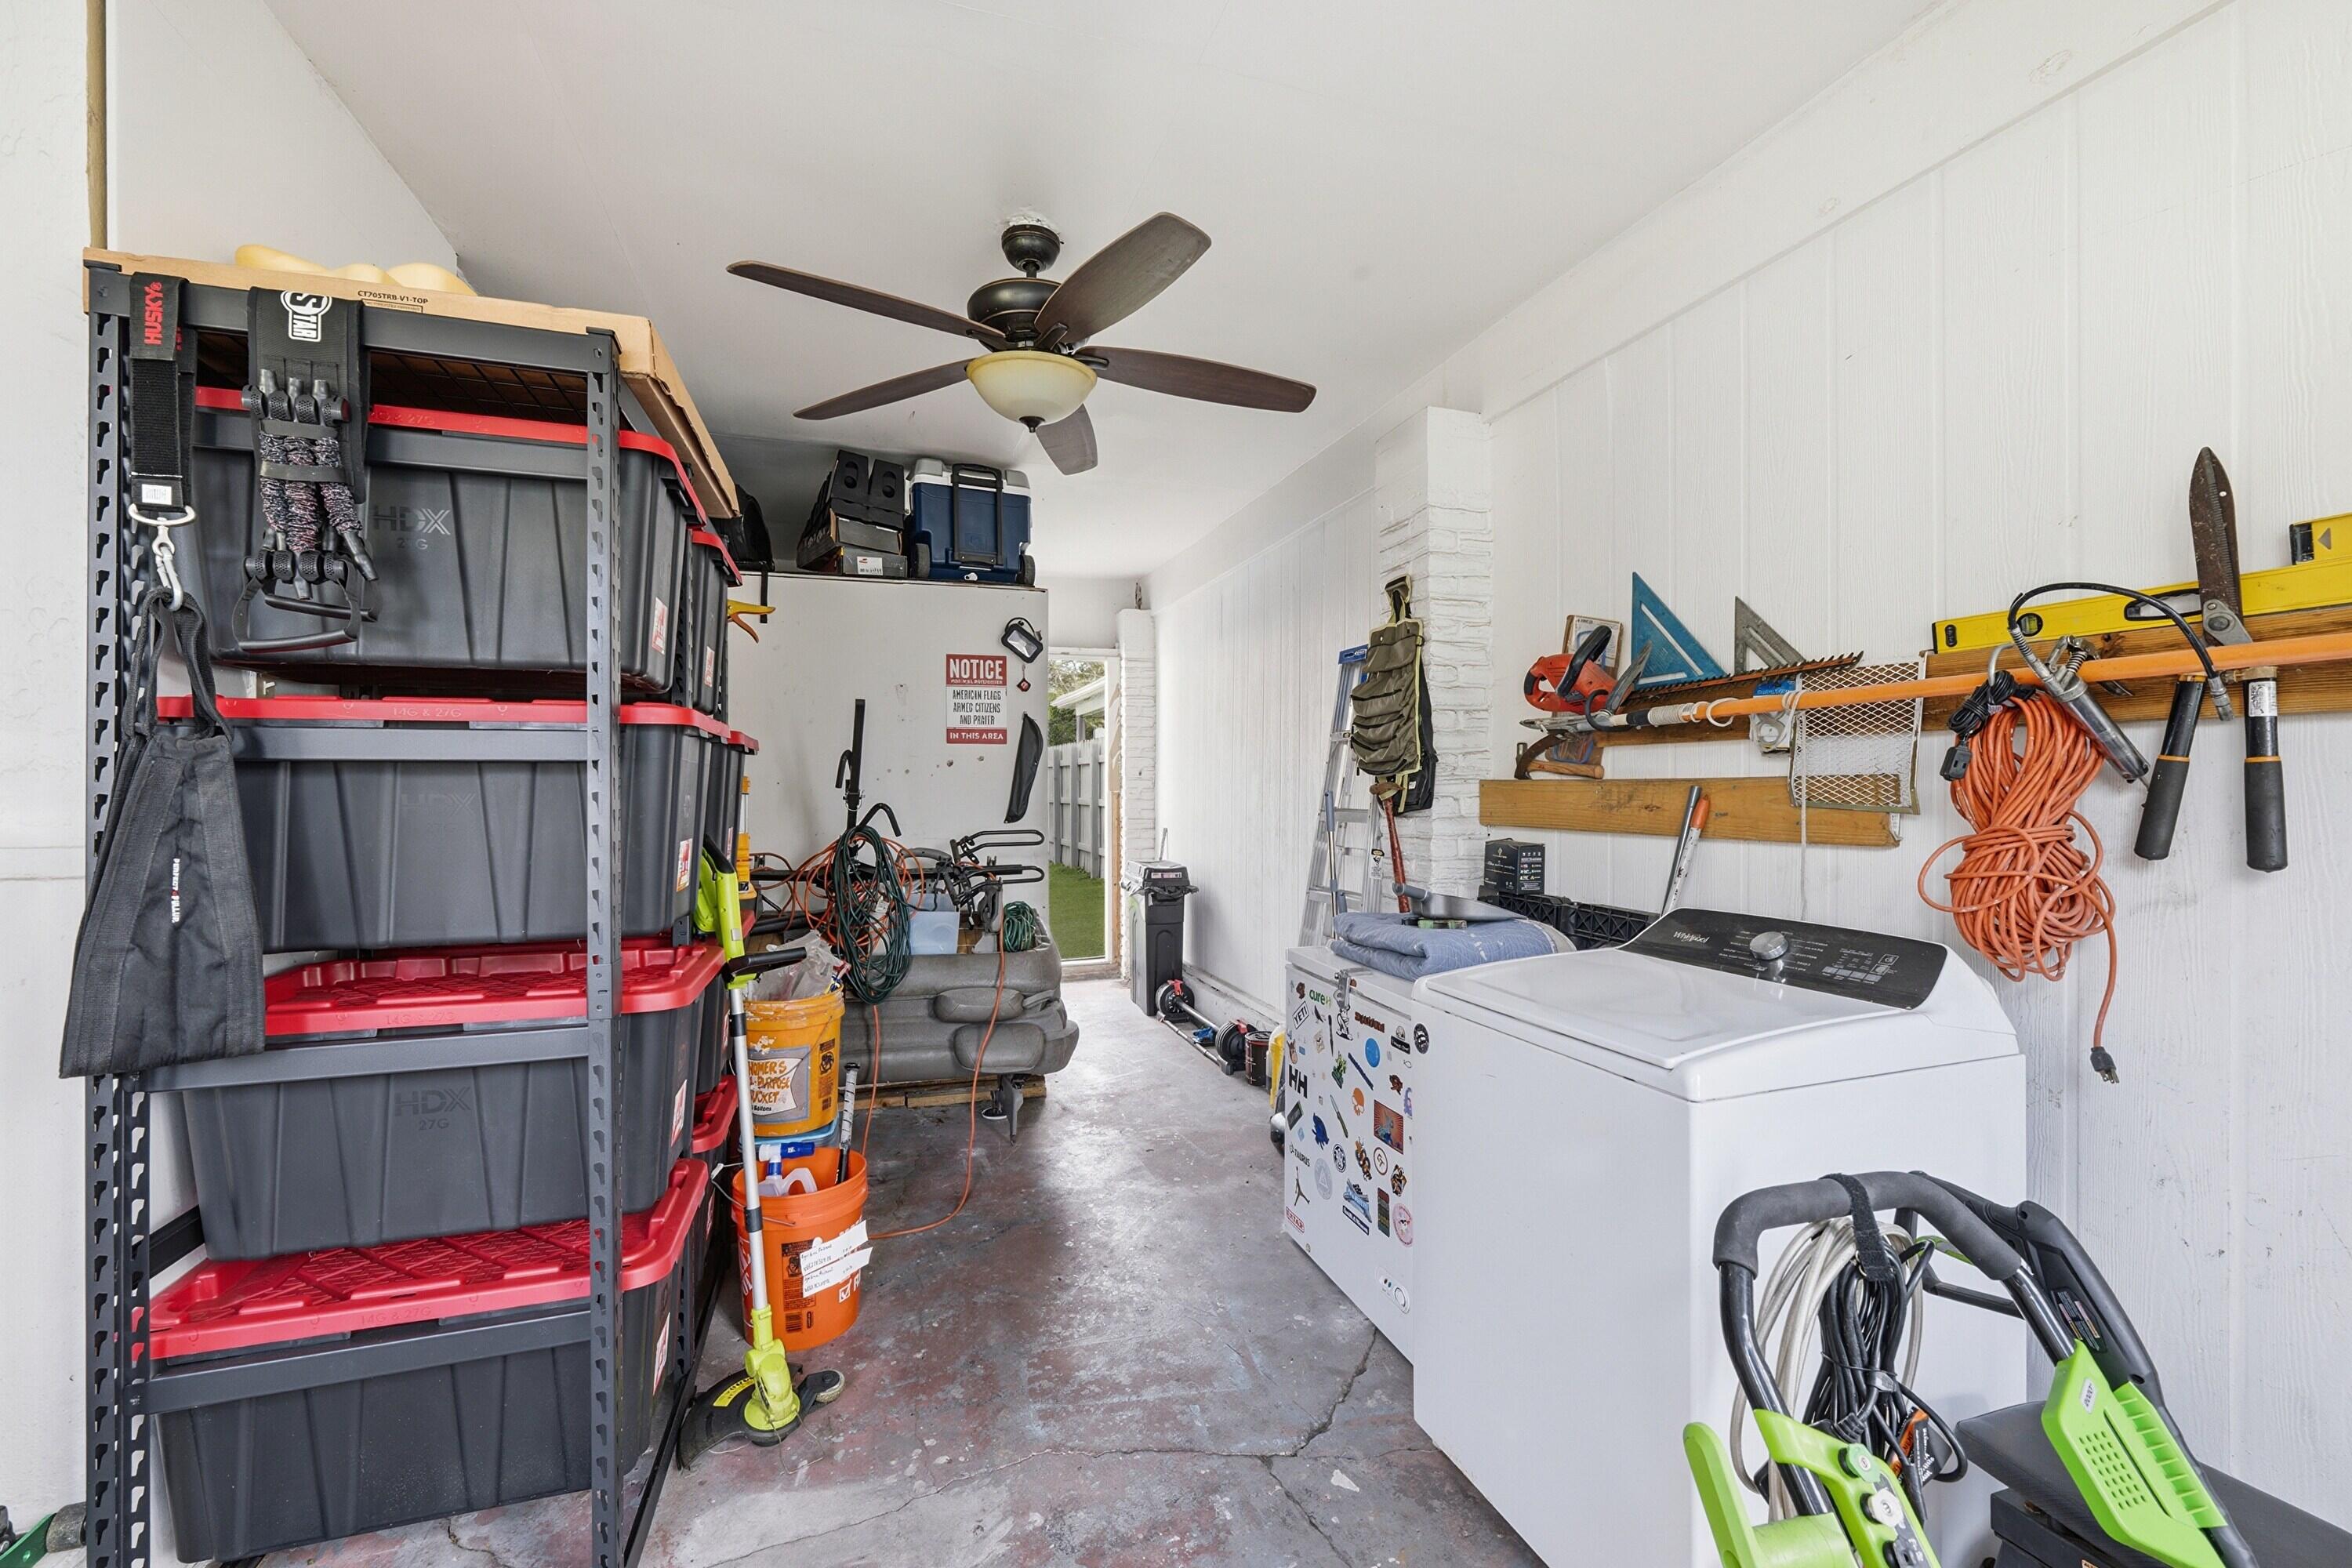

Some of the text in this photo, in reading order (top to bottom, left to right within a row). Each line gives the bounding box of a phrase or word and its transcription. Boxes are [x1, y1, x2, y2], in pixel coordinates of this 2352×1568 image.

[372, 506, 451, 535] HDX
[397, 539, 428, 550] 2G
[949, 659, 1004, 680] NOTICE
[953, 690, 1001, 700] AMERICAN FLAGS
[435, 707, 462, 717] 27G
[953, 702, 1000, 713] ARMED CITIZENS
[960, 715, 971, 724] AND
[1673, 931, 1710, 943] Whirlpool
[1294, 1006, 1308, 1025] YETI
[1289, 1064, 1308, 1099] HH
[394, 1087, 471, 1117] HDX
[419, 1118, 450, 1131] 27G
